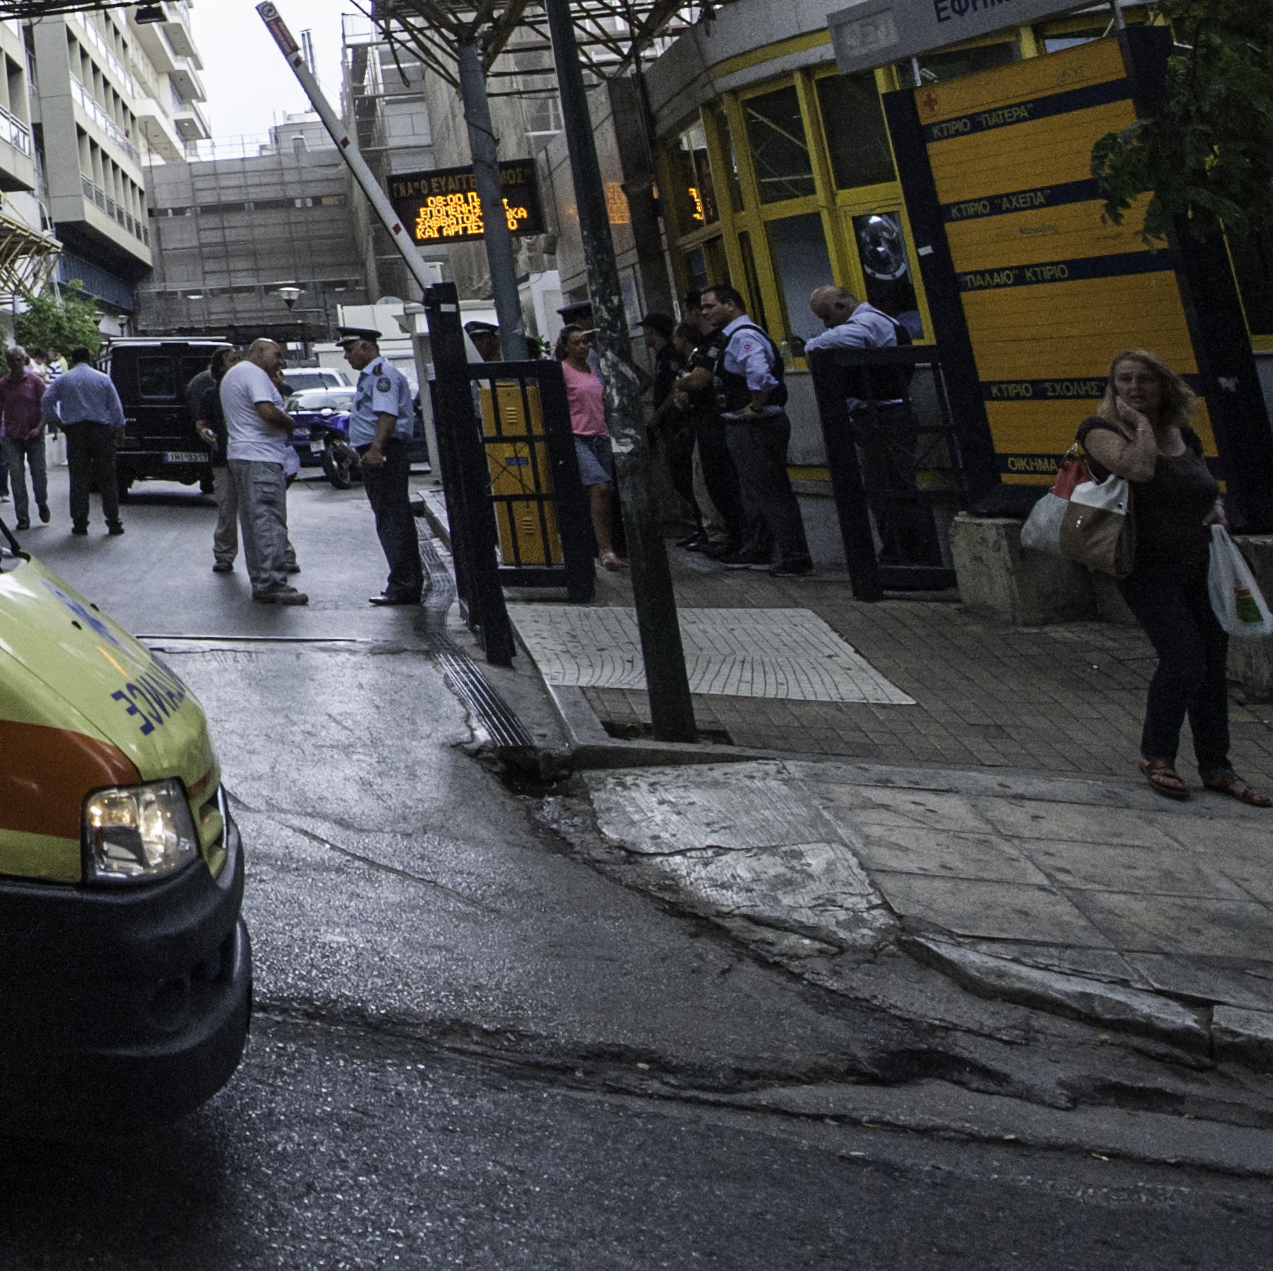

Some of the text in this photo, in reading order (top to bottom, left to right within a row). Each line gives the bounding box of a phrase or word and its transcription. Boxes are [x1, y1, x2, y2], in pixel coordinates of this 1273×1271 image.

[931, 118, 971, 139] ΚΤΙΡΙΟ
[950, 199, 991, 219] ΚΤΙΡΙΟ
[416, 226, 440, 240] ΚΑΙ
[1025, 264, 1069, 281] ΚΤΙΡΙΟ
[991, 382, 1033, 397] ΚΤΙΡΙΟ
[1007, 456, 1058, 472] ΟΙΚΗΜΑ
